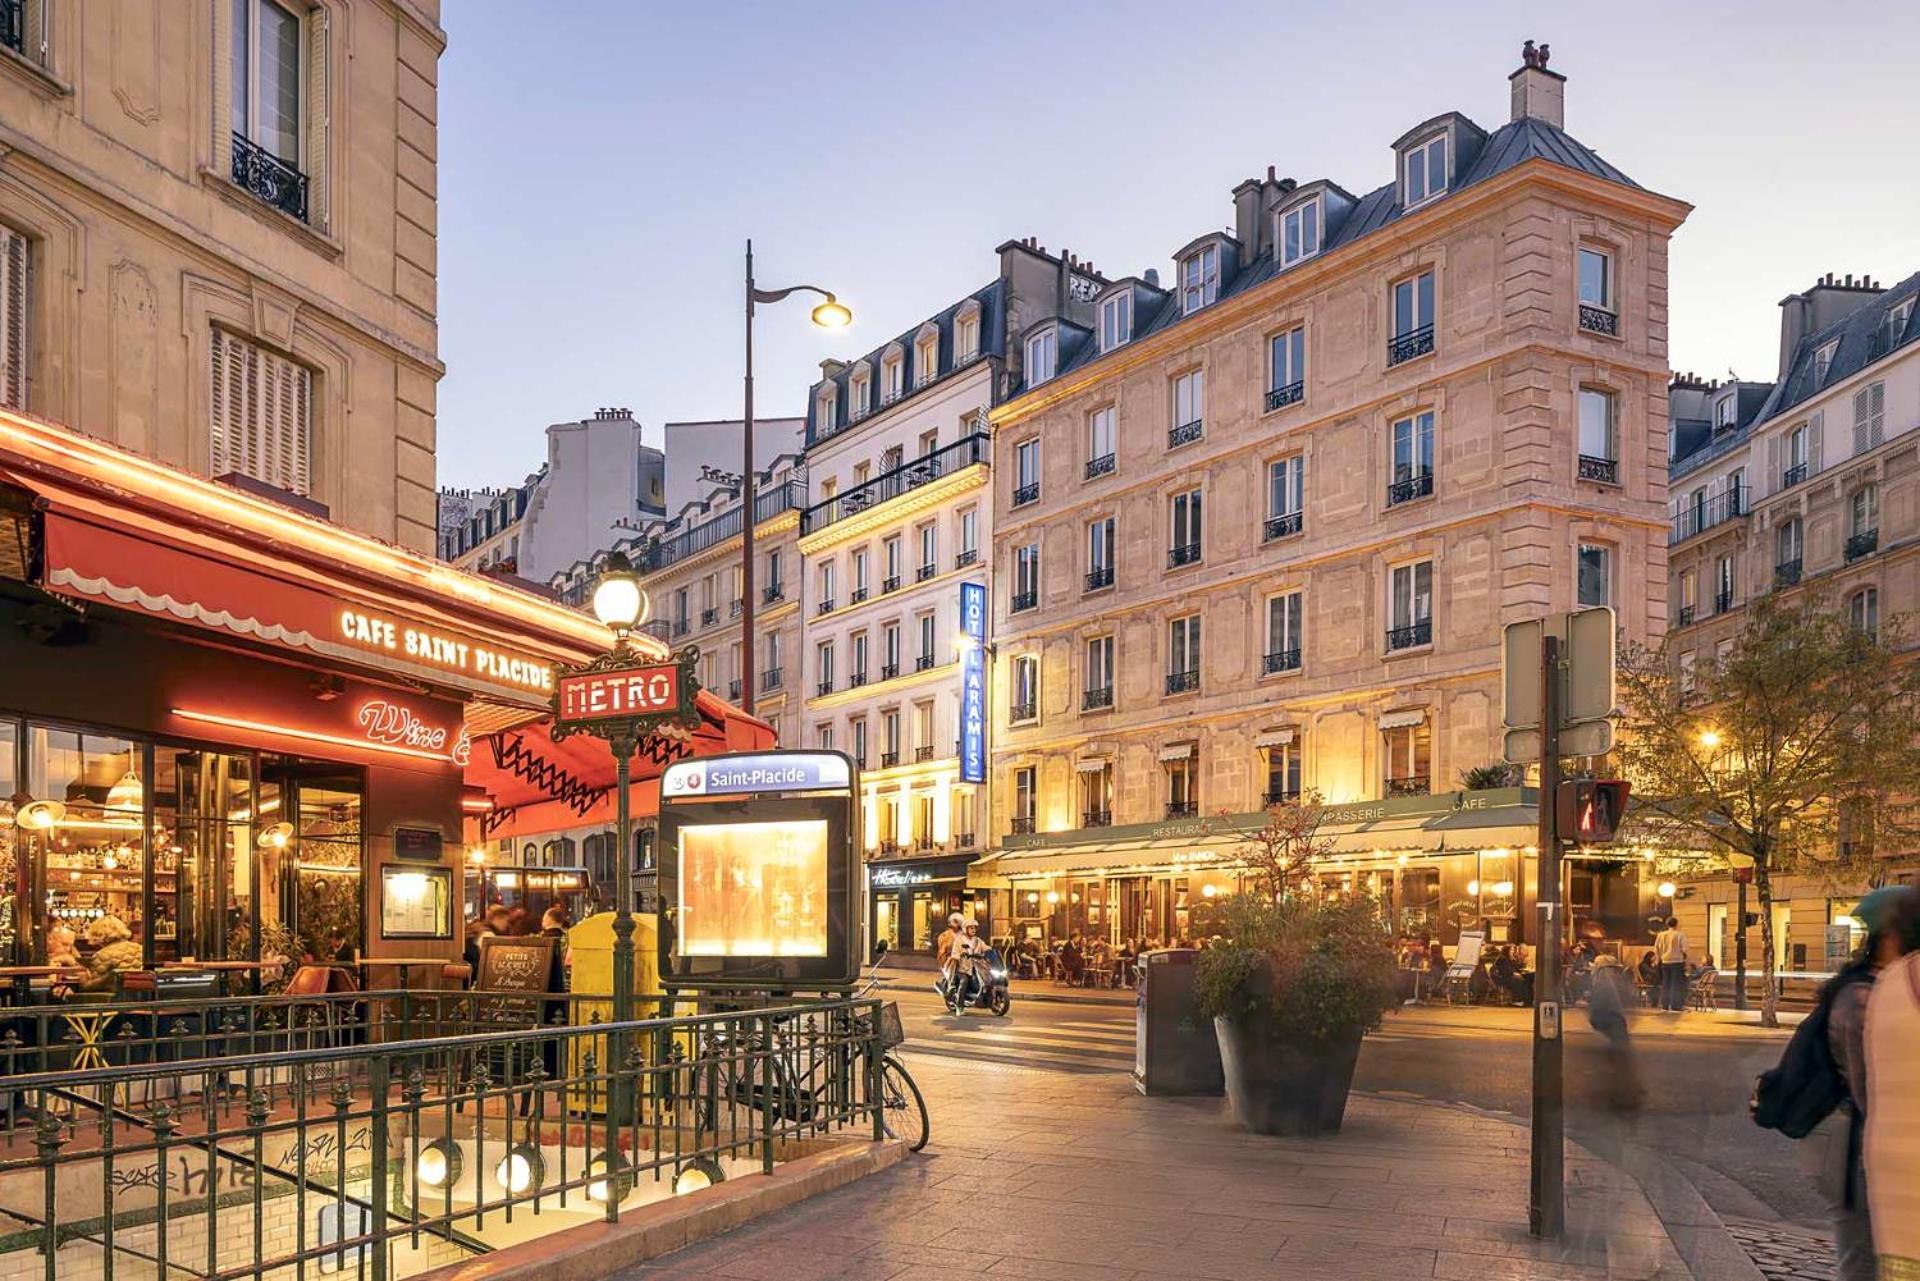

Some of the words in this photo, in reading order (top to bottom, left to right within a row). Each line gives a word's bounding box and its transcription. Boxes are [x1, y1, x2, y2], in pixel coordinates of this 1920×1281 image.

[968, 587, 981, 667] HOTL
[341, 611, 396, 649] CAFE
[404, 629, 468, 668] SAINT
[475, 648, 551, 689] PLACIDE
[567, 674, 670, 714] METRO
[359, 700, 446, 750] Wine
[967, 674, 981, 766] ARAMIS
[711, 769, 806, 787] Saint-Placide
[1452, 798, 1486, 811] CAFE
[1153, 823, 1211, 837] RESTAURAT
